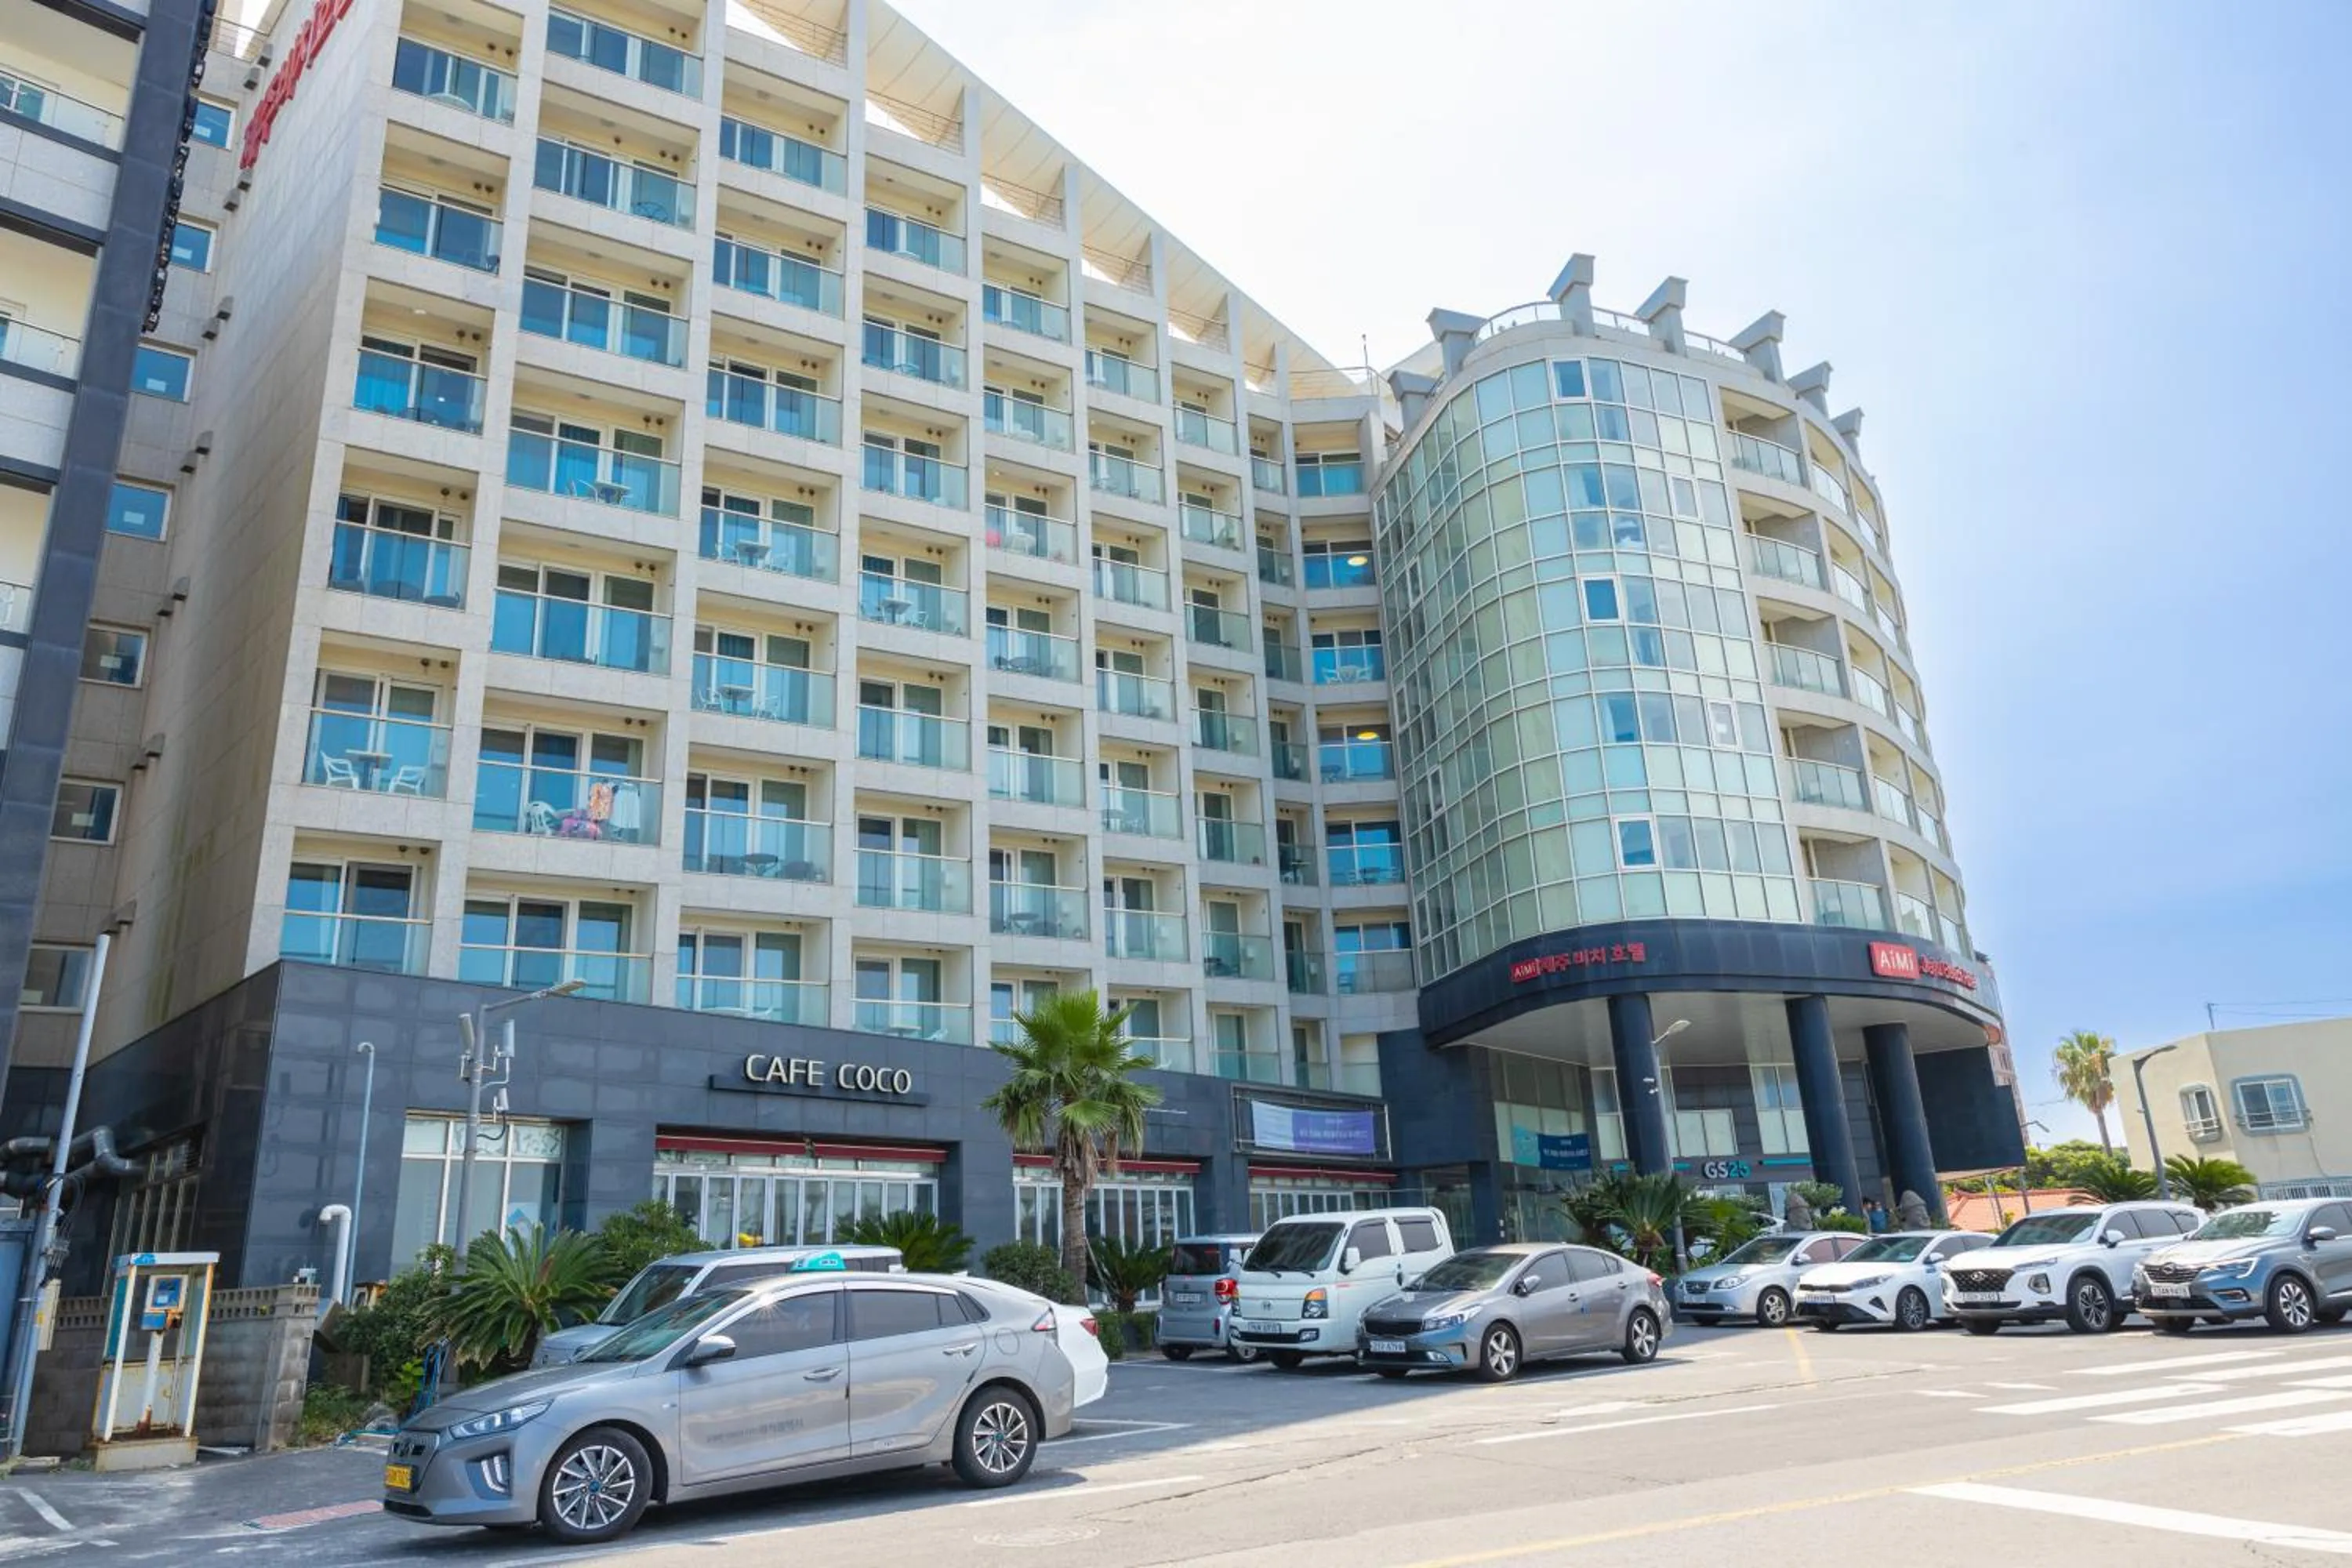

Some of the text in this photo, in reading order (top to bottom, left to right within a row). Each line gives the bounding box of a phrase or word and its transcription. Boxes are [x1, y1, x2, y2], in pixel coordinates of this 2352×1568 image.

[1881, 949, 1914, 972] AiMi
[746, 1054, 912, 1094] CAFE COCO
[1704, 1160, 1751, 1178] GS25
